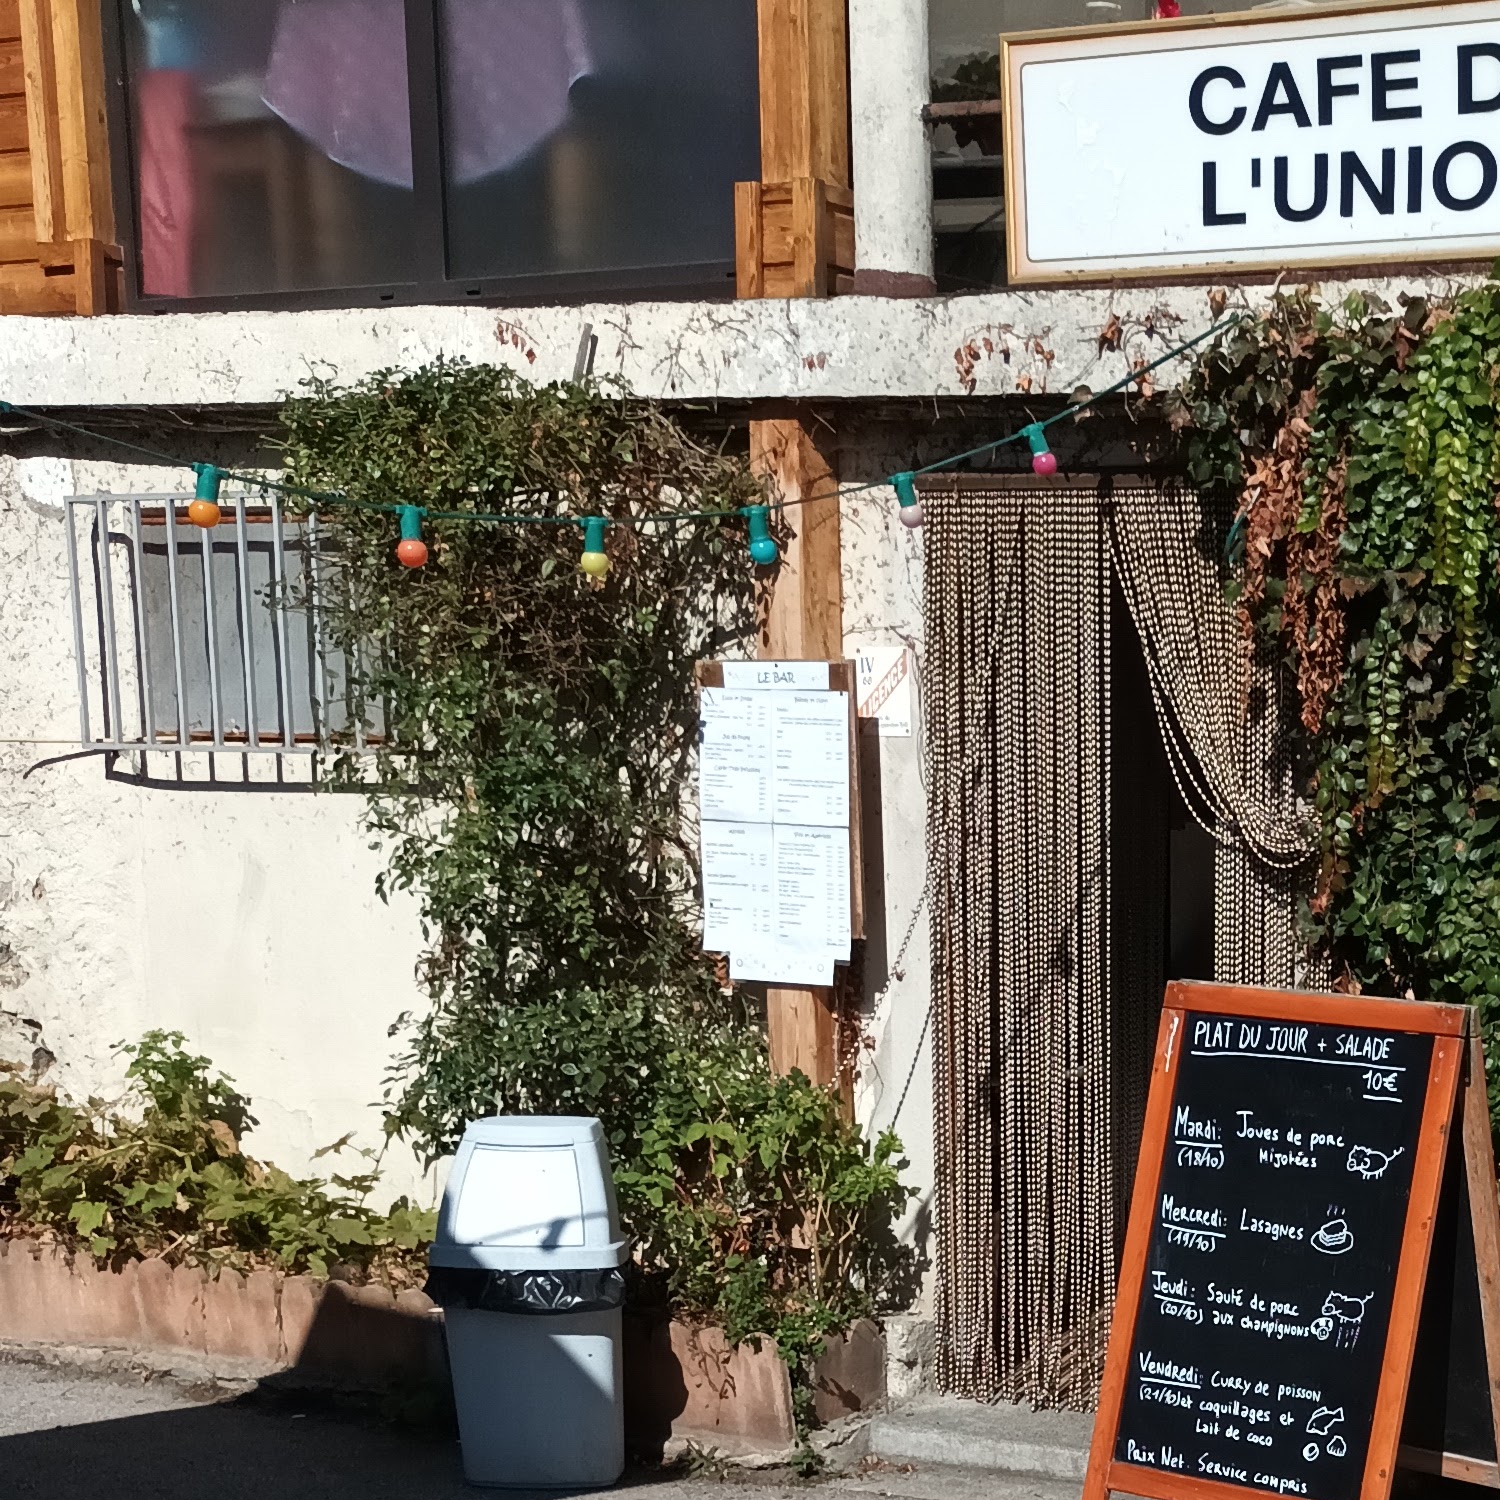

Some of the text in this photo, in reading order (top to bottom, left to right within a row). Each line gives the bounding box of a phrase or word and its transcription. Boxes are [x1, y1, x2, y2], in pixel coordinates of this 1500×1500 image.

[1188, 49, 1422, 135] CAFE
[757, 671, 797, 684] LE BAR
[862, 657, 905, 718] LICENCE
[1194, 1021, 1234, 1049] PLAT
[1238, 1023, 1262, 1049] DU
[1266, 1026, 1309, 1053] JOUR
[1335, 1033, 1395, 1061] SALADE
[1362, 1070, 1398, 1092] 10€
[1235, 1110, 1279, 1142] Joues
[1286, 1127, 1302, 1145] de
[1310, 1132, 1345, 1151] porc
[1177, 1147, 1225, 1169] (18/10)
[1167, 1228, 1216, 1252] (19/10)
[1240, 1208, 1304, 1241] Lasagnes
[1207, 1282, 1244, 1307] Sauté
[1250, 1293, 1266, 1312] de
[1270, 1301, 1300, 1318] porc
[1160, 1300, 1310, 1339] (20/10) aux champignons
[1211, 1370, 1252, 1396] Curry
[1254, 1381, 1270, 1397] de
[1277, 1383, 1322, 1402] poisson
[1199, 1400, 1271, 1425] coquillages
[1279, 1411, 1295, 1426] et
[1225, 1424, 1240, 1440] de
[1246, 1431, 1273, 1447] coco
[1127, 1439, 1155, 1464] Prix
[1198, 1452, 1247, 1482] Service
[1253, 1472, 1308, 1494] compris
